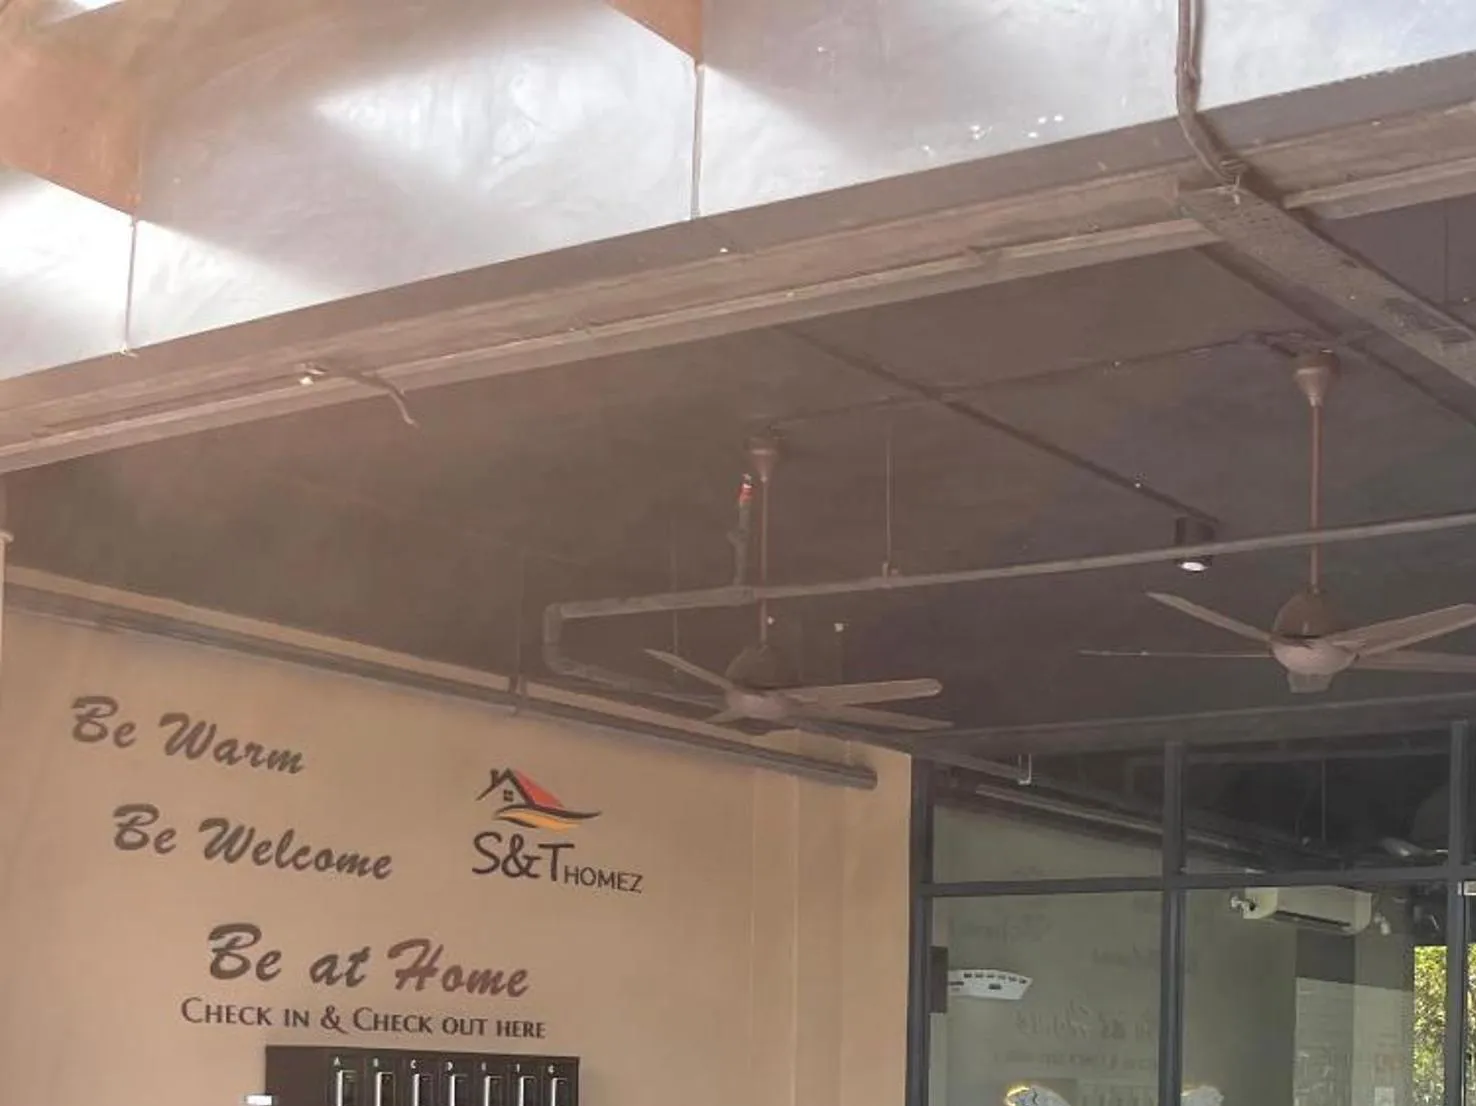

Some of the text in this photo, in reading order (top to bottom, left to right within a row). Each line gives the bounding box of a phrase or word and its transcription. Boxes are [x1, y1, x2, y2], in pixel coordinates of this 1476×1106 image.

[71, 695, 304, 774] Be Warm
[112, 802, 393, 880] Be Welcome
[207, 922, 529, 998] Be at Home
[319, 1004, 348, 1034] &
